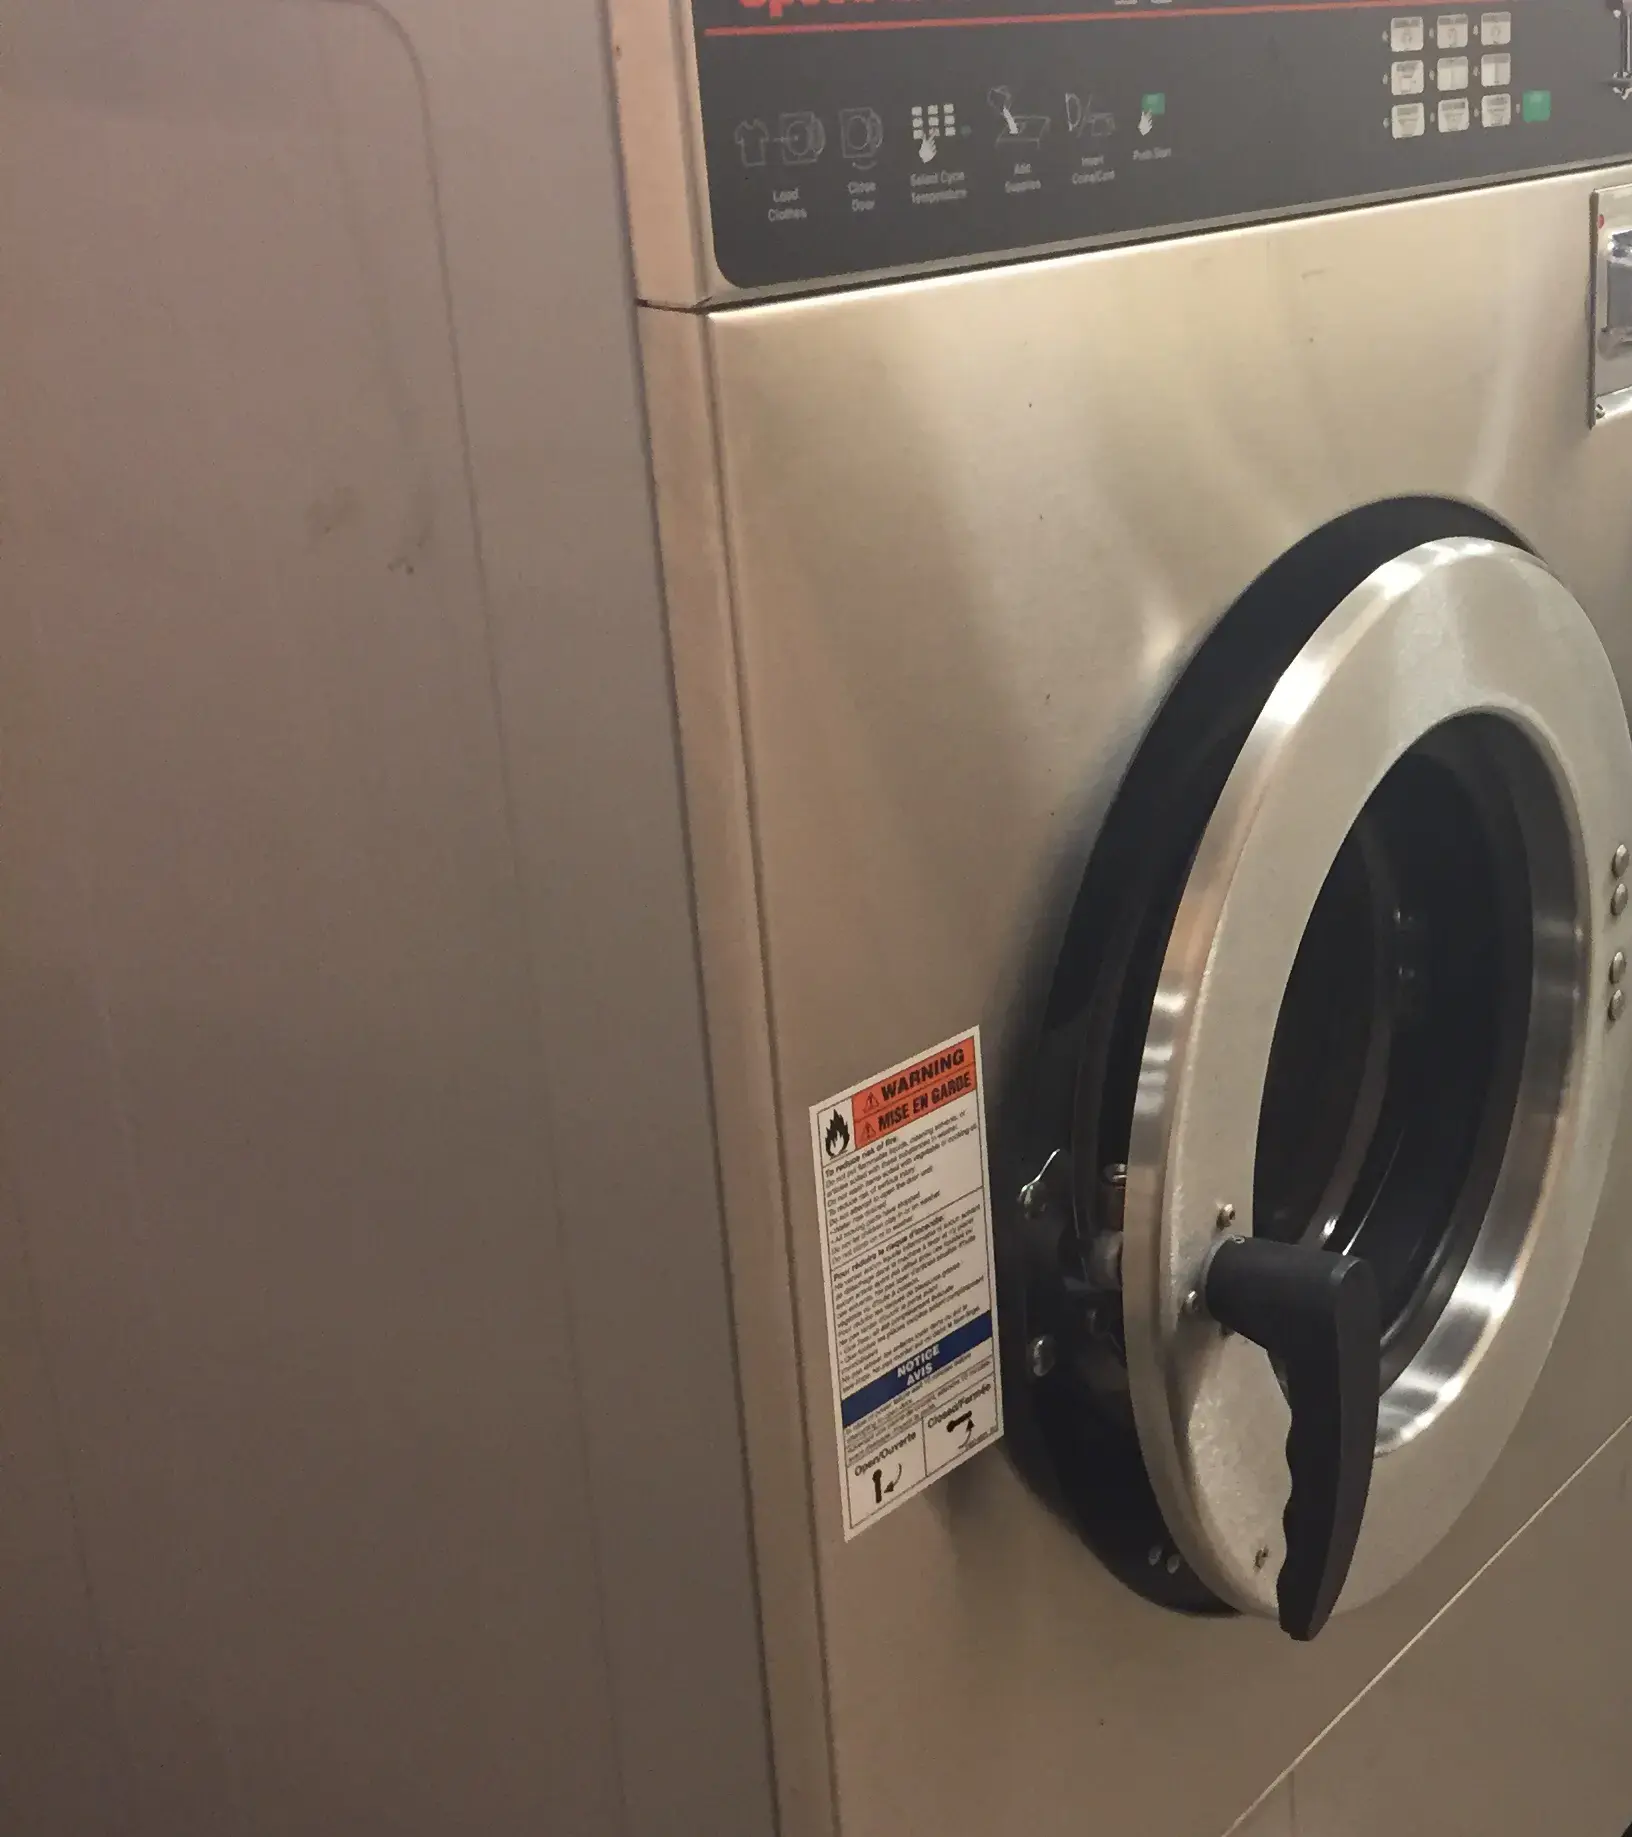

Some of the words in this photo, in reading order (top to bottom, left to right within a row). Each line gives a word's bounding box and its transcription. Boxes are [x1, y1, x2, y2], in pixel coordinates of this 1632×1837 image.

[880, 1048, 965, 1101] WARNING
[877, 1106, 910, 1132] MISE
[913, 1099, 929, 1115] EN
[931, 1071, 973, 1105] GARDE
[896, 1344, 940, 1378] NOTICE
[906, 1362, 933, 1386] AVIS
[927, 1383, 991, 1429] Closed/Fermée
[854, 1431, 917, 1477] Open/Ouverte
